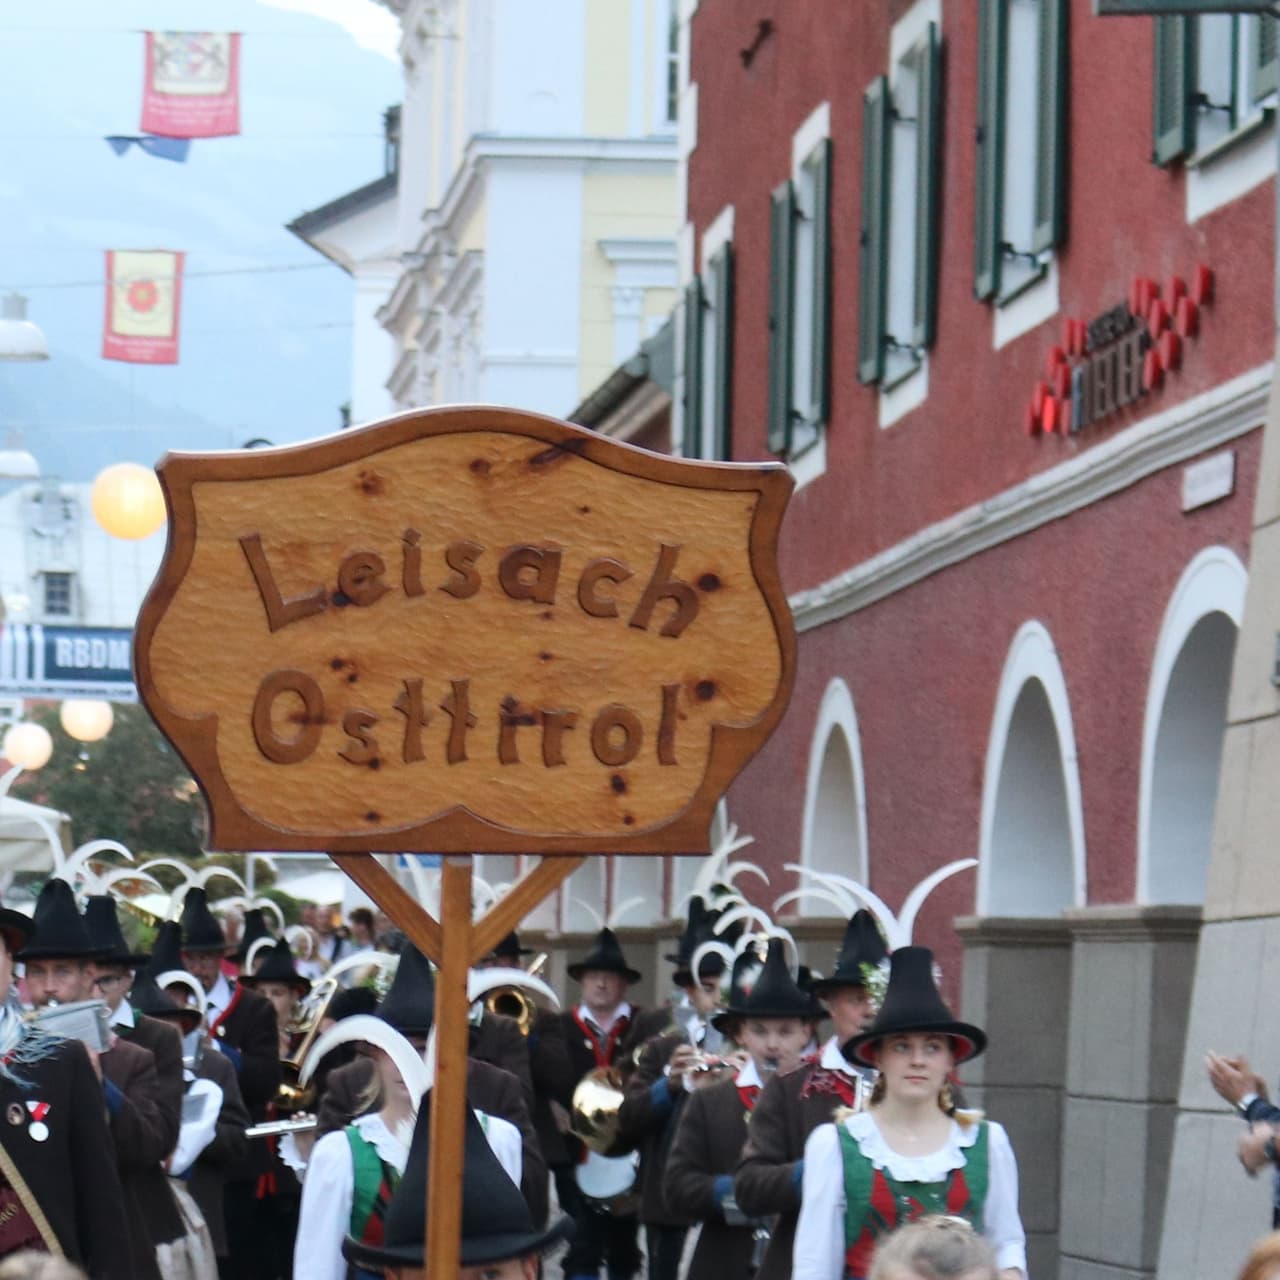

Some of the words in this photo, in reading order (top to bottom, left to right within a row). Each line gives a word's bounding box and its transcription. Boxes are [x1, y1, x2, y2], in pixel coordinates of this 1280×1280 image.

[238, 528, 701, 638] Leisach
[55, 636, 130, 669] RBDM
[250, 670, 682, 768] Osttirol
